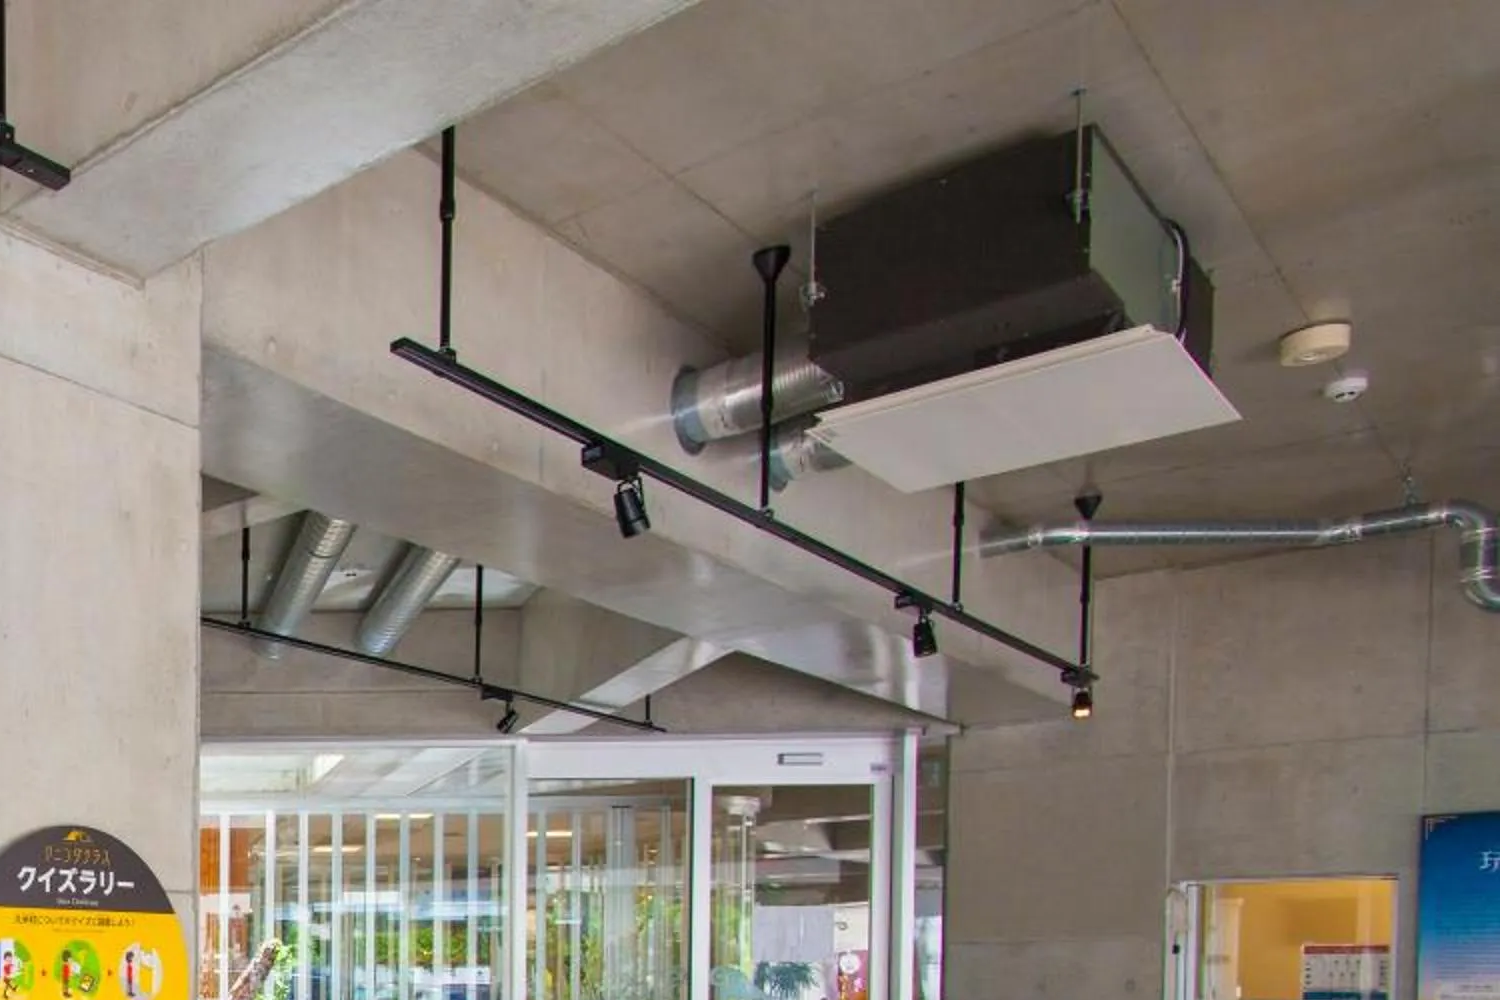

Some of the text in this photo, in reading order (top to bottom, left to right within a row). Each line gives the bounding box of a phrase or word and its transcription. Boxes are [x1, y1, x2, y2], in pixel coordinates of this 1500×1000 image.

[17, 866, 135, 896] クイズラリー
